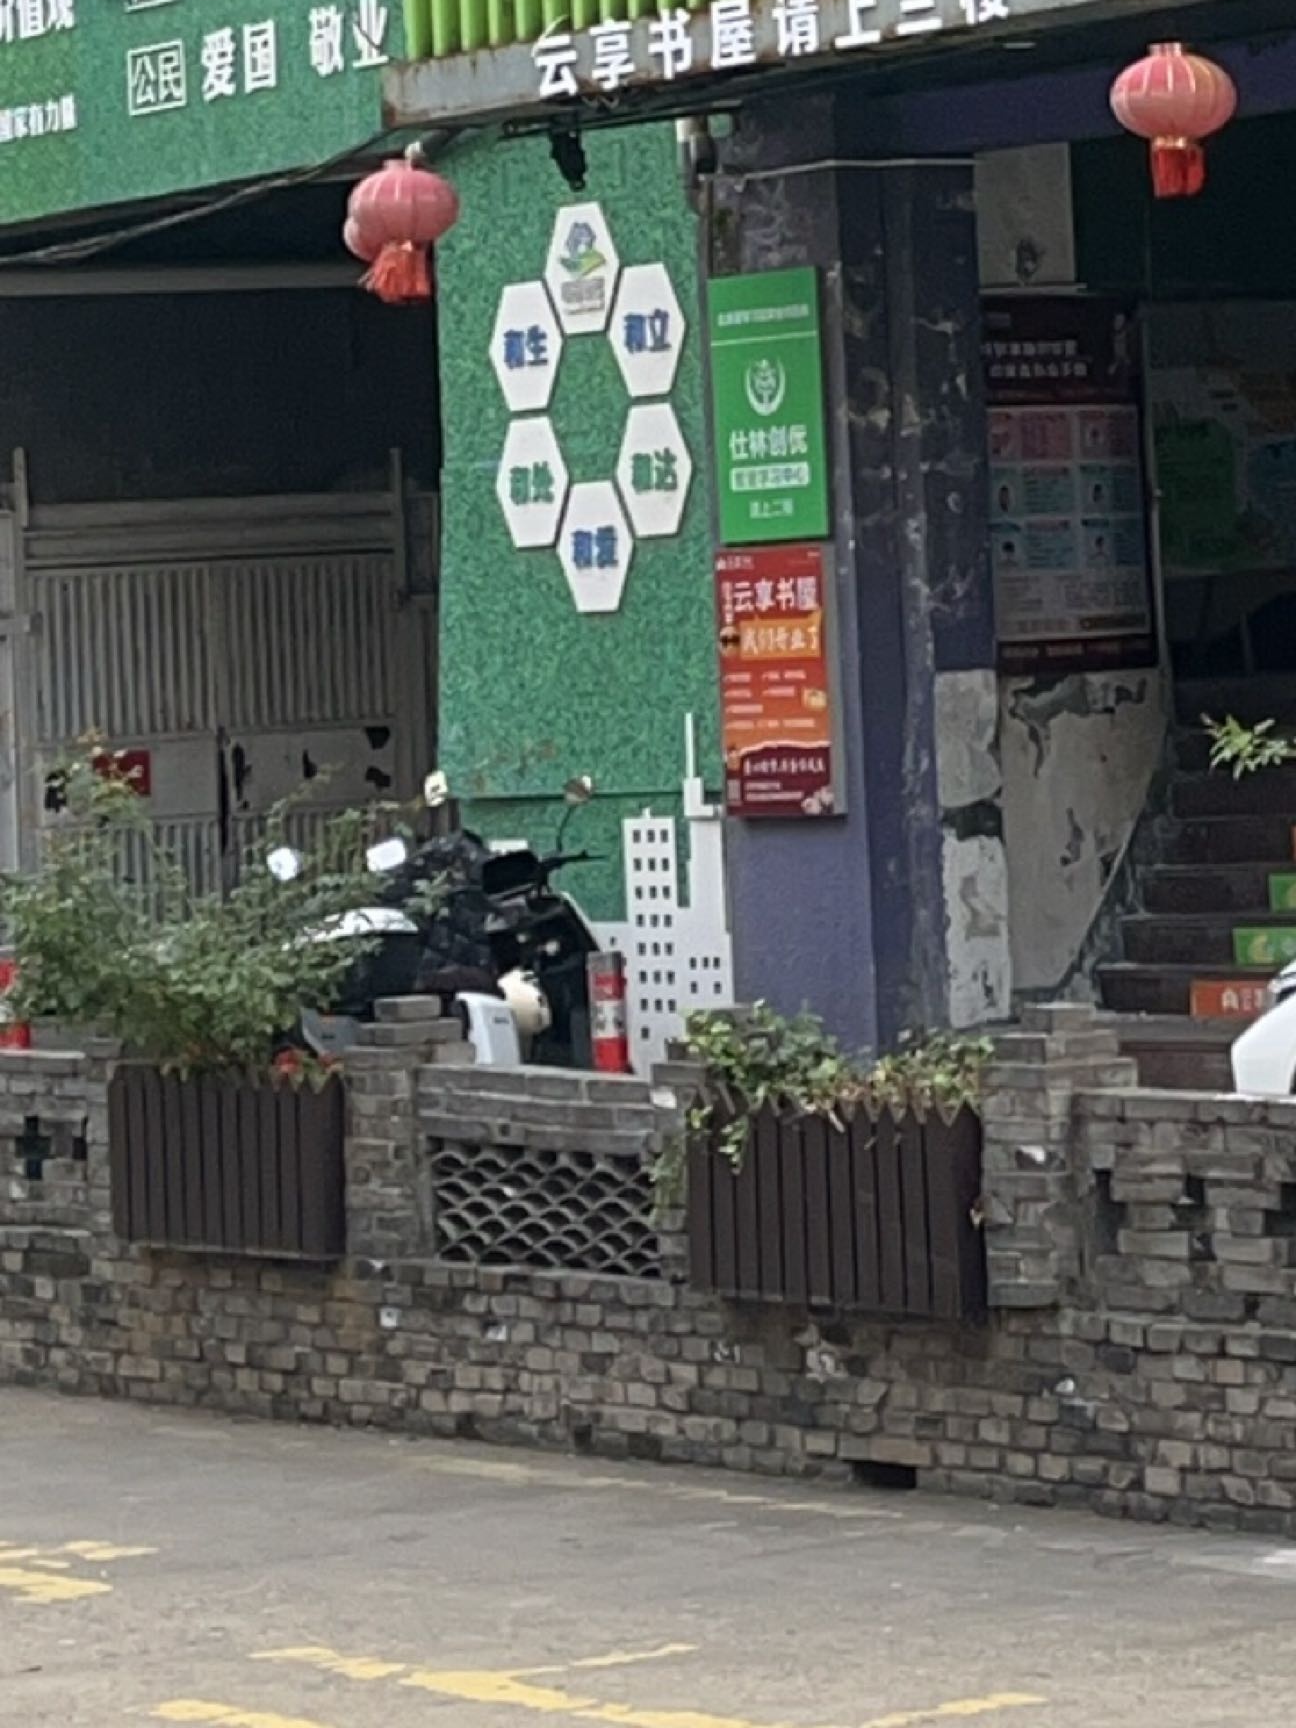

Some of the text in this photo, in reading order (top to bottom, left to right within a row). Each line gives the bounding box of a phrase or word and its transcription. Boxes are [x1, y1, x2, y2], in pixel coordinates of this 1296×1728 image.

[133, 52, 184, 105] 公民
[201, 19, 277, 103] 爱国
[733, 575, 818, 613] 云享书屋
